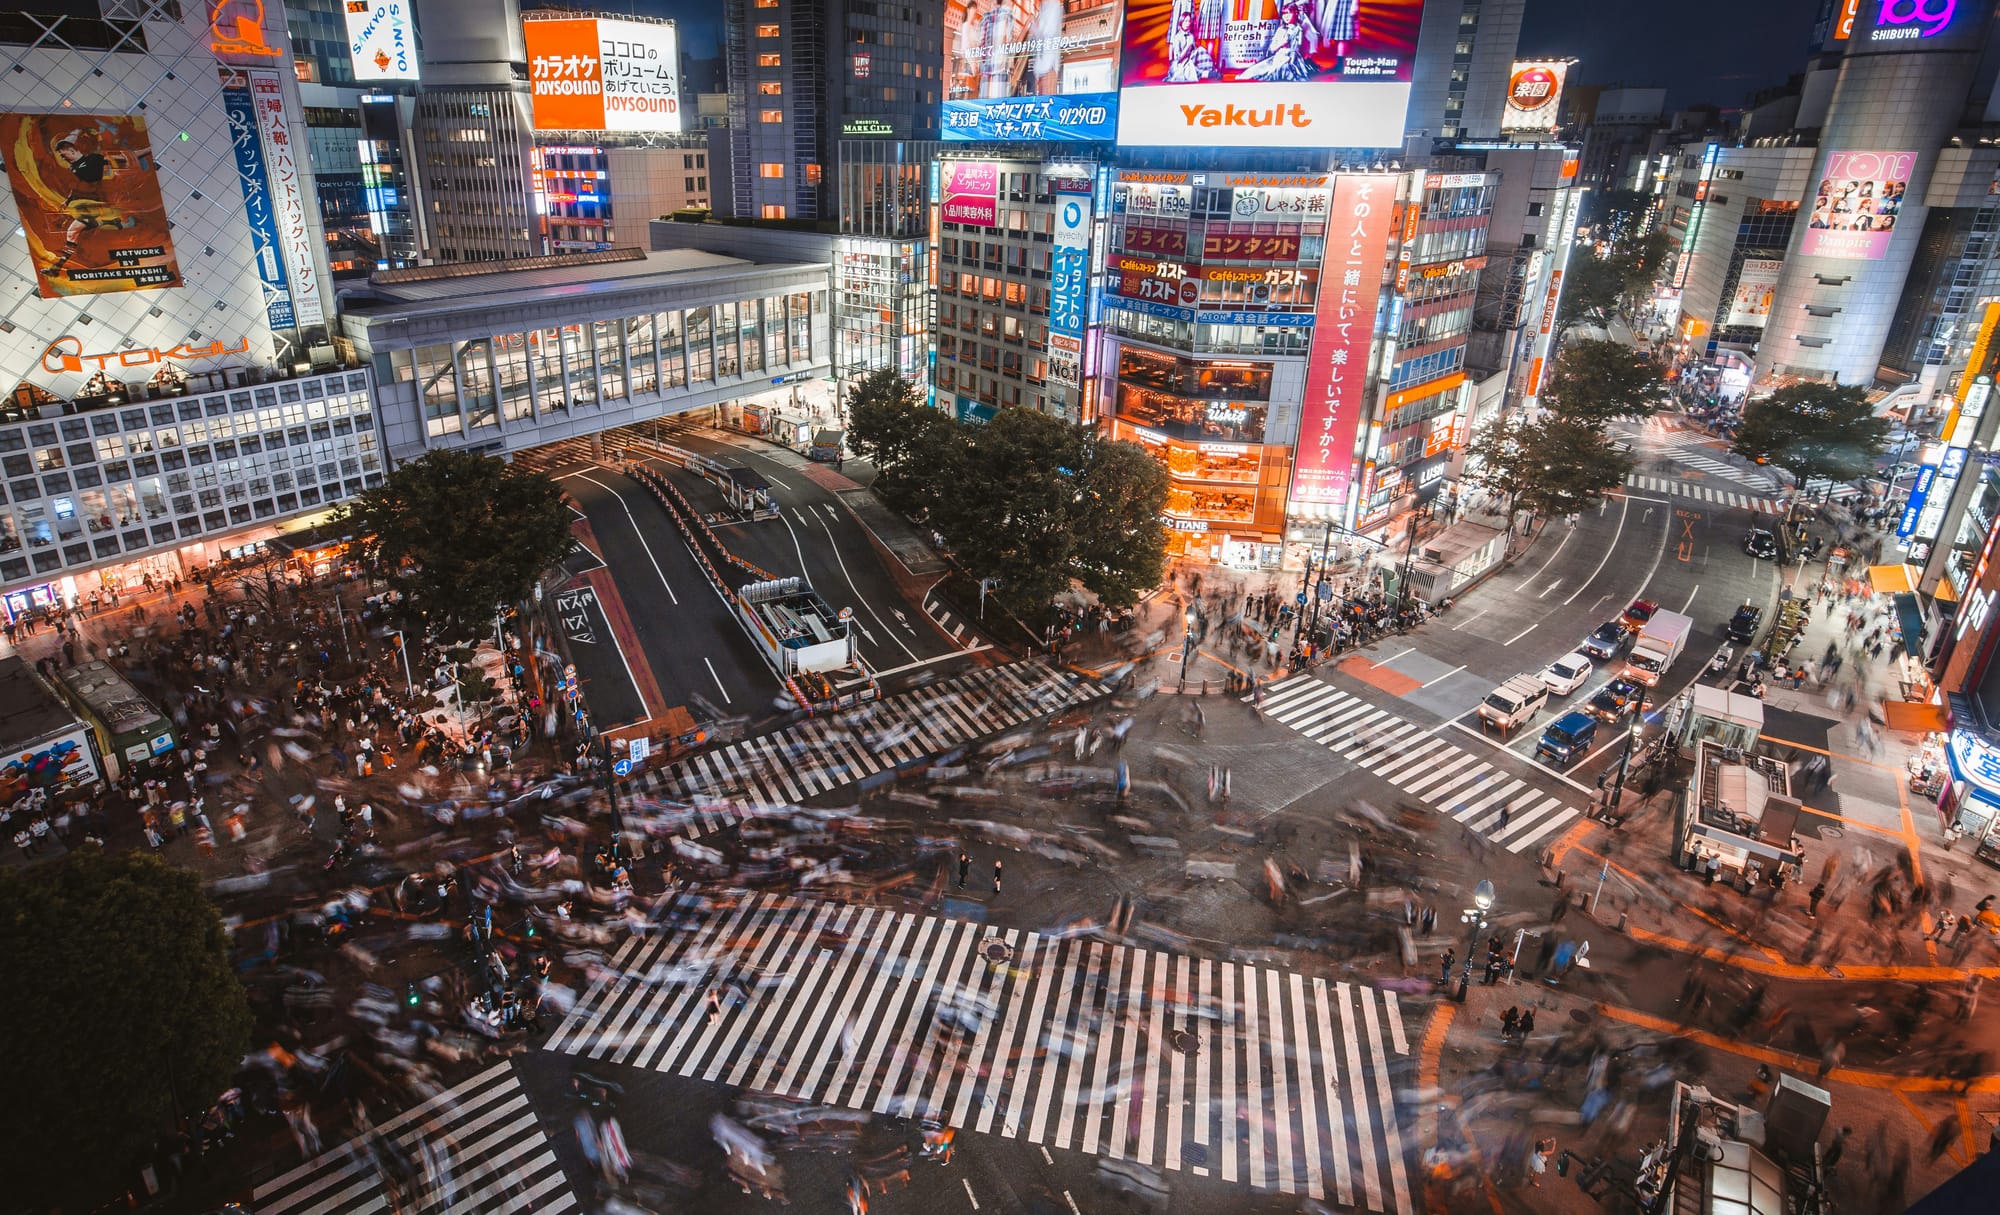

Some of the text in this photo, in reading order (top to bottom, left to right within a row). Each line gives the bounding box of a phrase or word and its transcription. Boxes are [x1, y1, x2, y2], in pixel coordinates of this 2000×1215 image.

[353, 6, 386, 55] SANKYO
[389, 3, 413, 72] SANKYO
[1223, 32, 1263, 41] Refresh
[1871, 28, 1920, 40] SHIBUYA
[211, 43, 283, 56] TOKYU
[602, 40, 658, 59] ココロの
[533, 54, 597, 78] カラオケ
[1345, 57, 1398, 67] Tough-Man
[604, 60, 674, 81] ボリューム、
[1344, 66, 1381, 75] Refresh
[535, 80, 601, 95] JOYSOUND
[605, 79, 676, 96] あげていこう。
[606, 96, 676, 113] JOYSOUND
[949, 99, 1106, 127] 第53回 スプリンターズ 9/29(日)
[1180, 104, 1312, 127] Yakult
[994, 121, 1045, 137] ステークス
[965, 180, 991, 191] クリニック
[1114, 193, 1127, 203] 9F
[1265, 194, 1326, 212] しゃぶ葉
[949, 205, 993, 221] 品川美容外科
[1126, 229, 1185, 251] プライス
[1205, 237, 1297, 256] コンタクト
[115, 248, 160, 257] ARTWORK
[74, 268, 163, 279] NORITAKE KINASHI
[1156, 262, 1187, 280] ガスト
[1264, 269, 1308, 285] ガスト
[1108, 276, 1121, 287] 7F
[1140, 279, 1176, 300] ガスト
[1201, 313, 1227, 321] AEON
[1233, 314, 1313, 324] 英会話イーオン
[81, 337, 249, 370] TOKYU
[1050, 358, 1079, 382] No.1
[1421, 463, 1446, 484] LUSH
[1308, 485, 1343, 497] tinder
